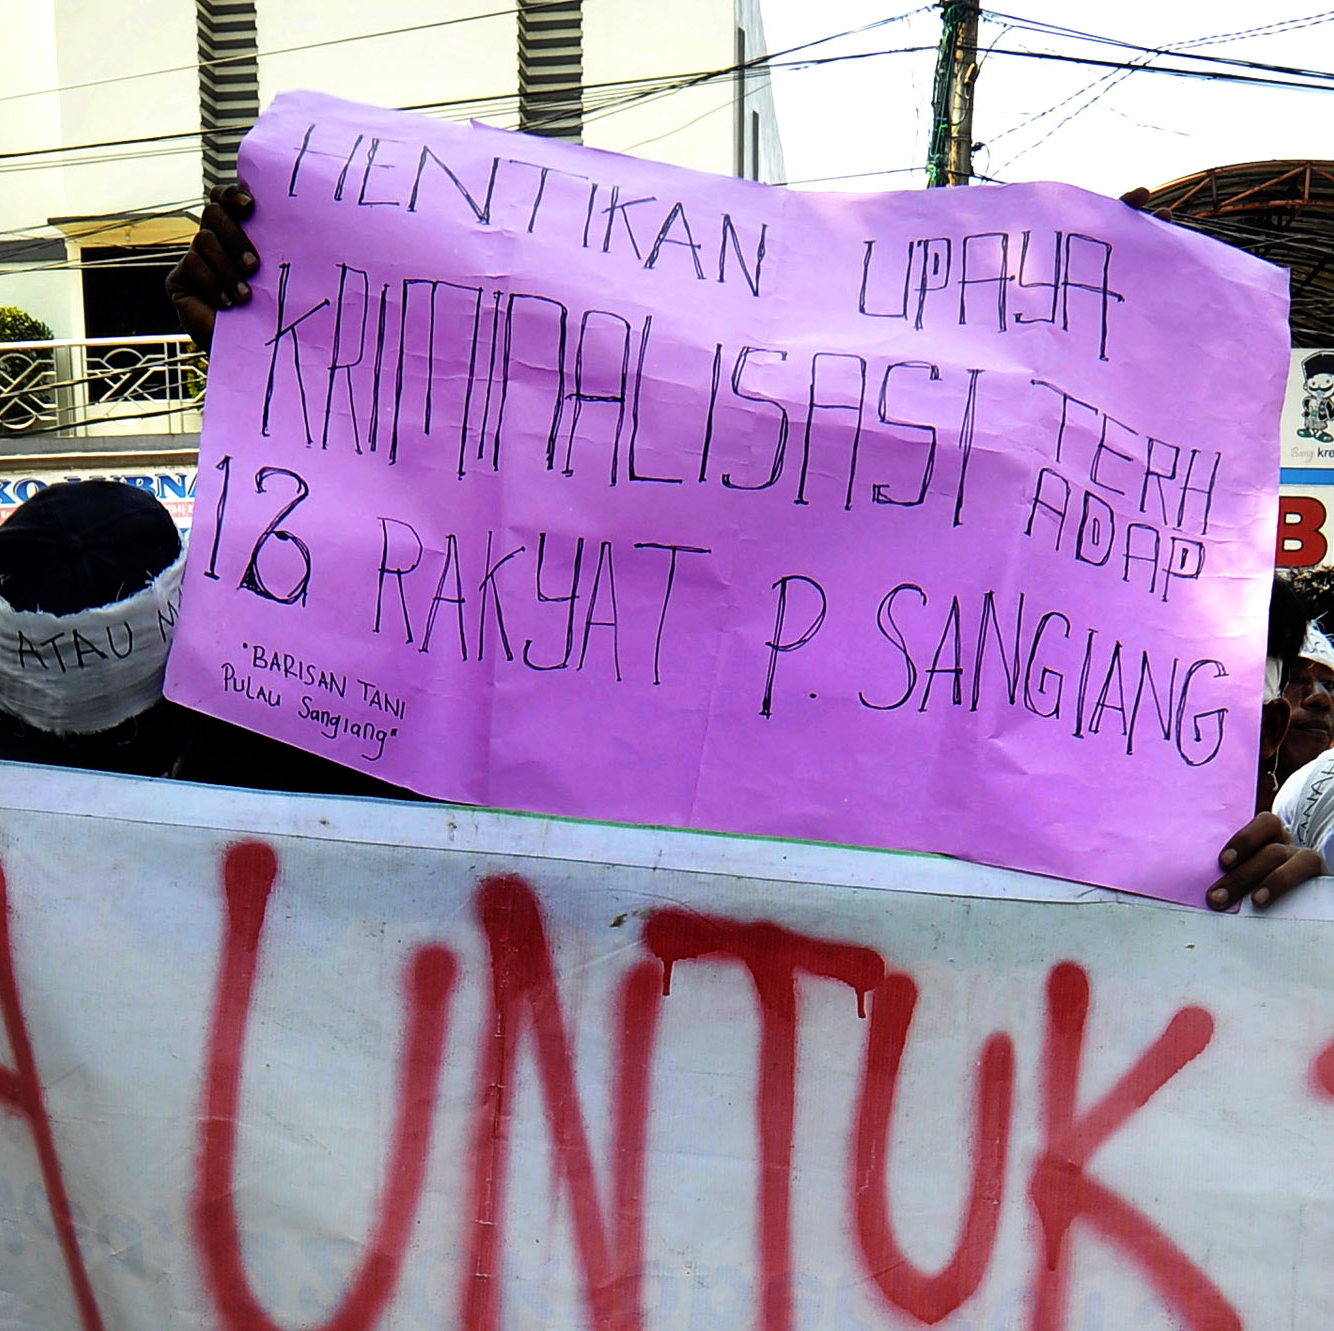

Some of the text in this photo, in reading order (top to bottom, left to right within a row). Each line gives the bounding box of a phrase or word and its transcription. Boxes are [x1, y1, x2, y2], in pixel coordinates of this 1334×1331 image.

[289, 123, 1124, 361] HENTIKAN UPAYA
[262, 263, 1221, 535] KRIMINALISASI TERH
[1025, 467, 1207, 602] ADAP
[18, 620, 134, 673] ATAU
[357, 678, 406, 720] TANI
[373, 516, 712, 685] RAKYAT
[759, 575, 818, 718] P.
[859, 583, 1229, 766] SANGIANG
